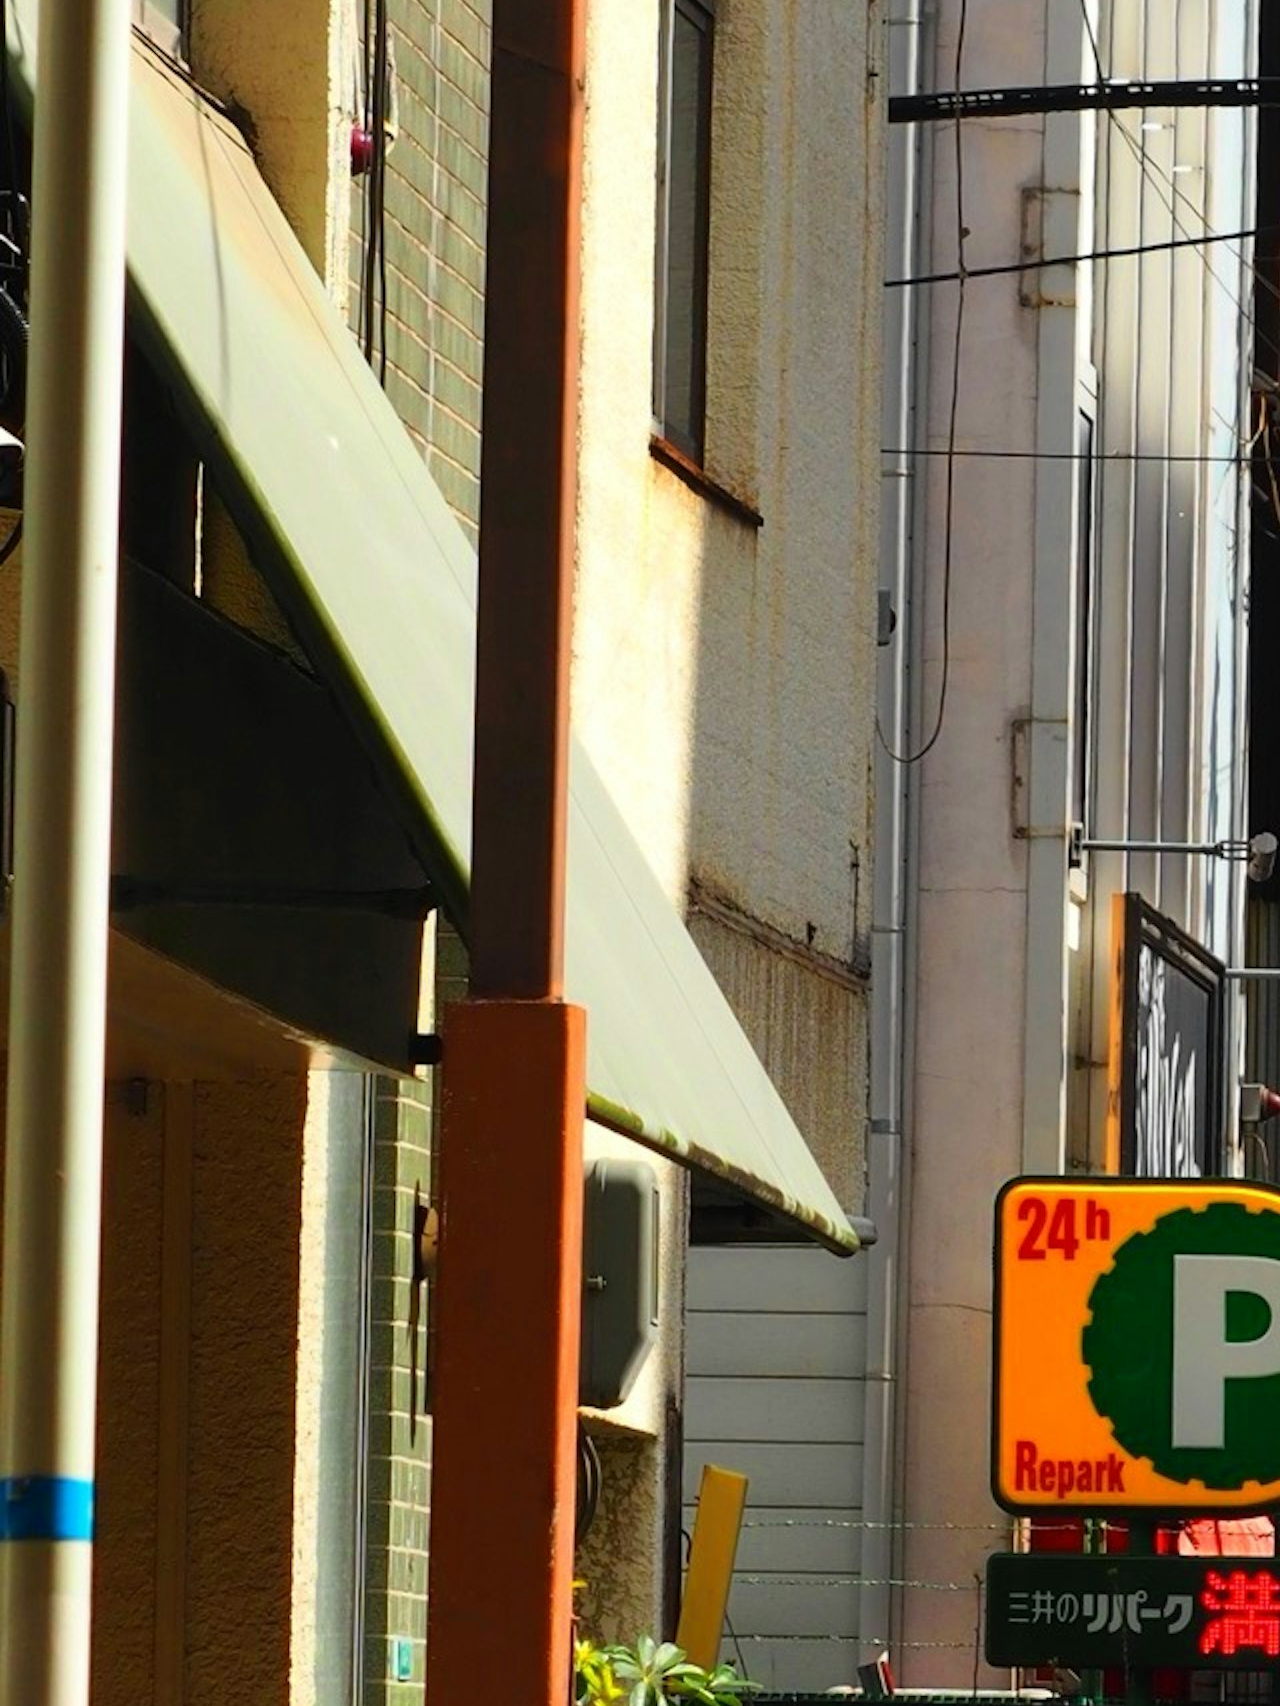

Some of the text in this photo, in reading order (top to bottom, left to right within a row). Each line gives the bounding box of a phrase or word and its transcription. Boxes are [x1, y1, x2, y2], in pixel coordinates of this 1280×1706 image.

[1017, 1196, 1111, 1261] 24h
[1015, 1441, 1125, 1499] Repark
[1008, 1588, 1193, 1634] 三井のリパーク
